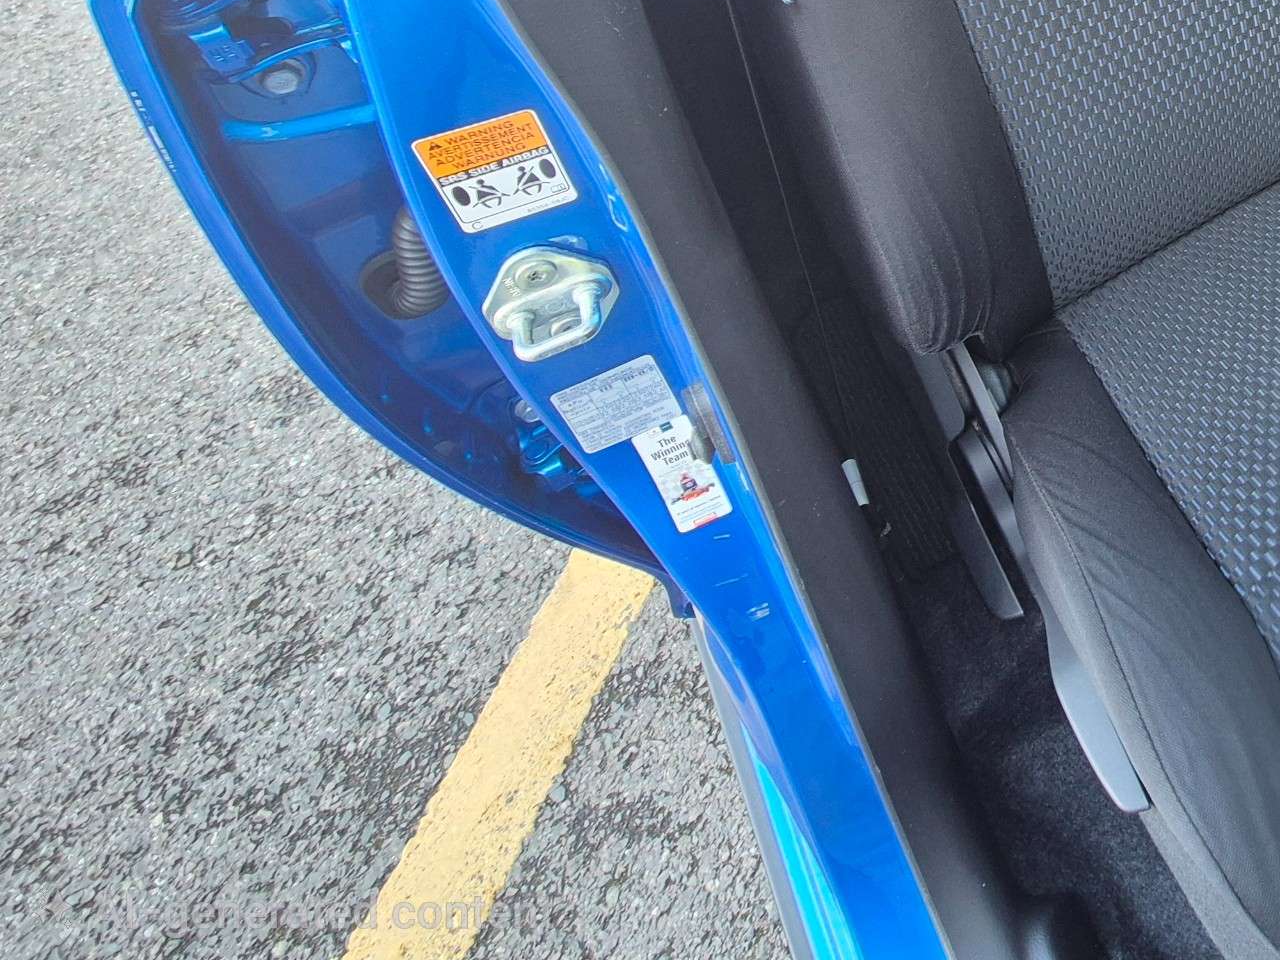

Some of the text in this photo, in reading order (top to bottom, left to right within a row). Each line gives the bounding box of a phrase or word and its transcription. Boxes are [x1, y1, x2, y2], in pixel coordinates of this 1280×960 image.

[428, 123, 533, 160] AVERTISSEMENT
[445, 120, 514, 146] WARNING
[435, 132, 535, 166] ADVERTENCIA
[451, 143, 527, 169] WARNUNG
[439, 147, 549, 187] SRS SIDE AIRBAG
[658, 436, 677, 448] The
[663, 450, 689, 466] Team
